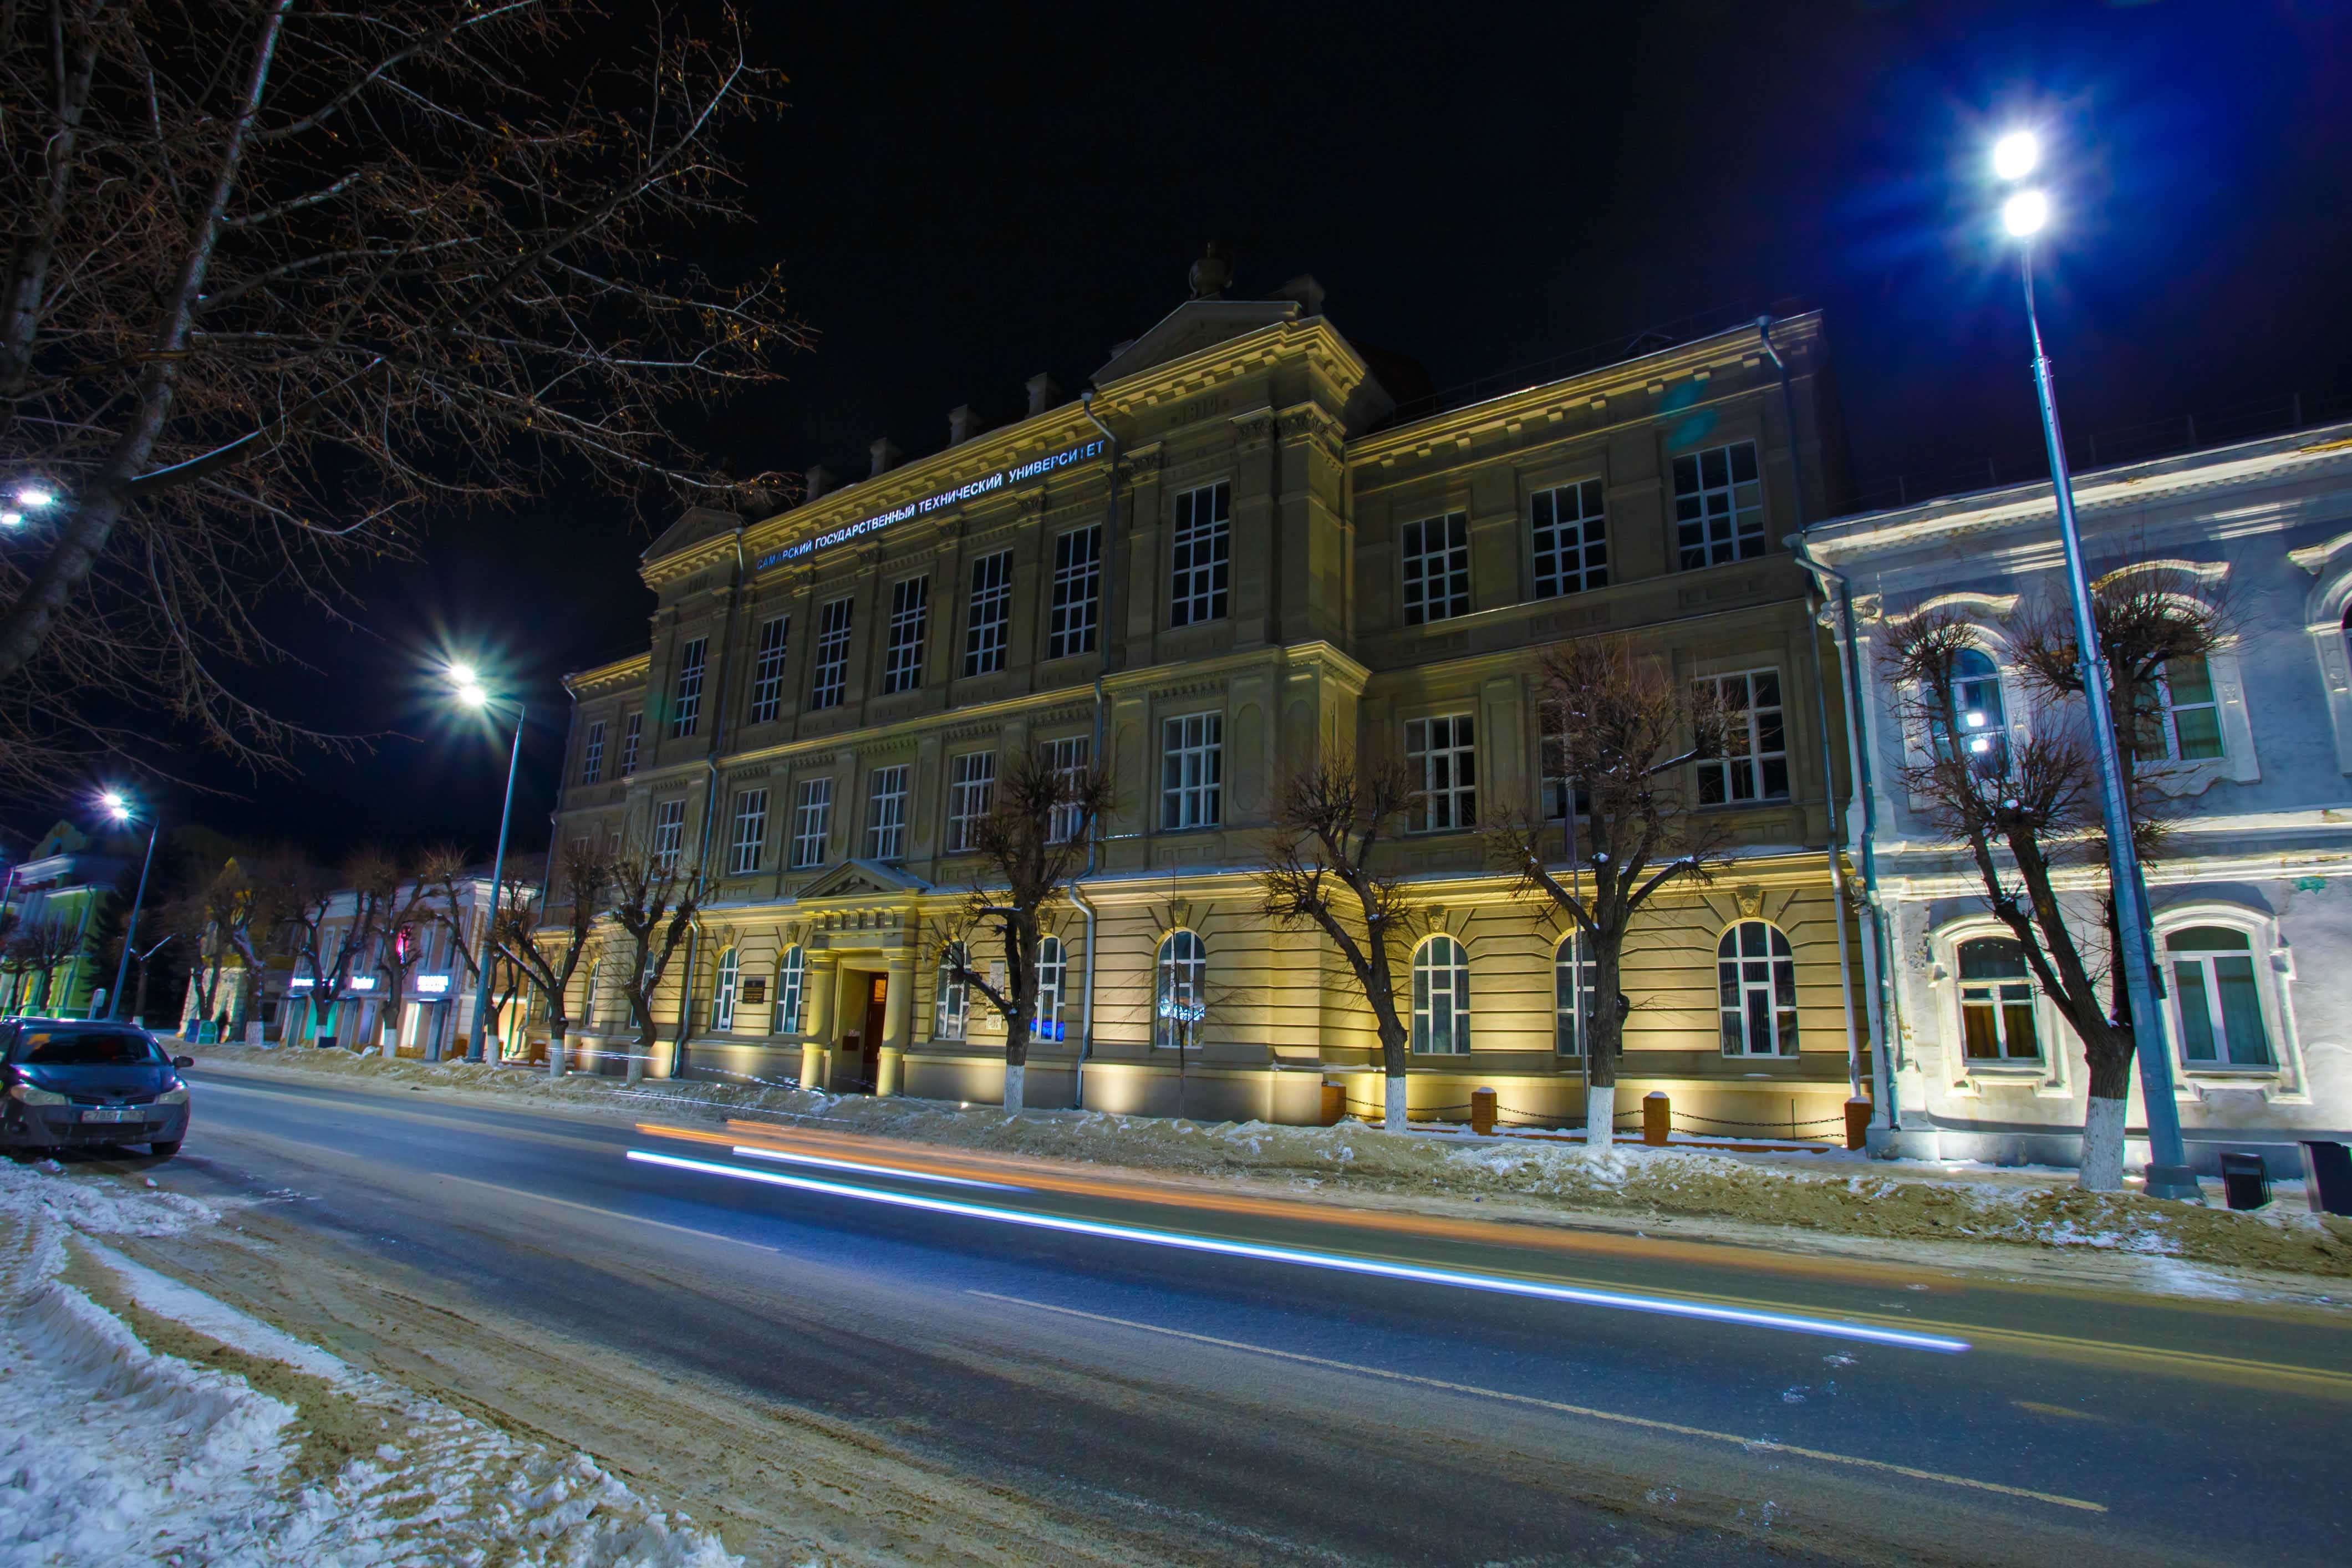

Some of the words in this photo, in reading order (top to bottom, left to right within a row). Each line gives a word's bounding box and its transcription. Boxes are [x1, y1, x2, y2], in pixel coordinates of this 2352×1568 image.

[756, 539, 812, 570] САМАРСКИЙ
[815, 504, 915, 549] ГОСУДАРСТВЕННЫЙ
[918, 473, 1002, 514] ТЕХНИЧЕСКИЙ
[1009, 440, 1105, 483] УНИВЕРСИТЕТ
